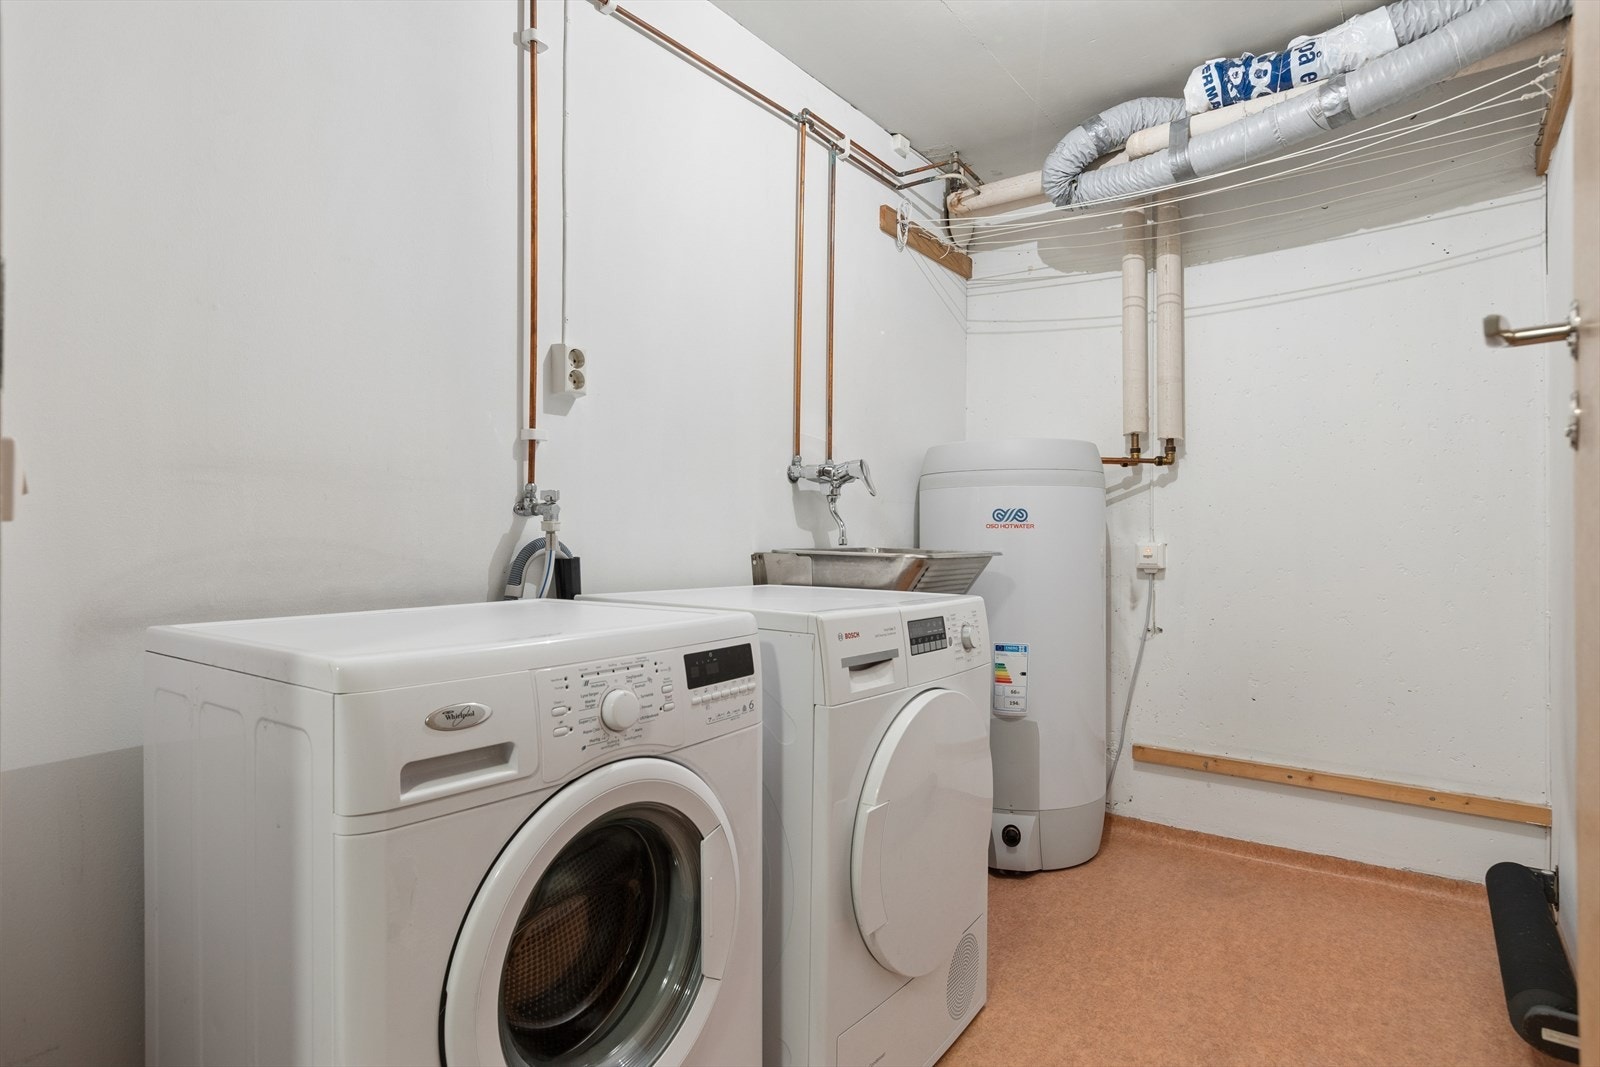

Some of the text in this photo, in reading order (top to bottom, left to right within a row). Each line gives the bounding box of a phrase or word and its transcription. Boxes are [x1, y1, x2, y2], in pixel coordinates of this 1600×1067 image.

[1295, 41, 1322, 66] på
[844, 631, 860, 640] BOSCH
[748, 699, 755, 710] 6
[444, 707, 476, 724] Whirlpool
